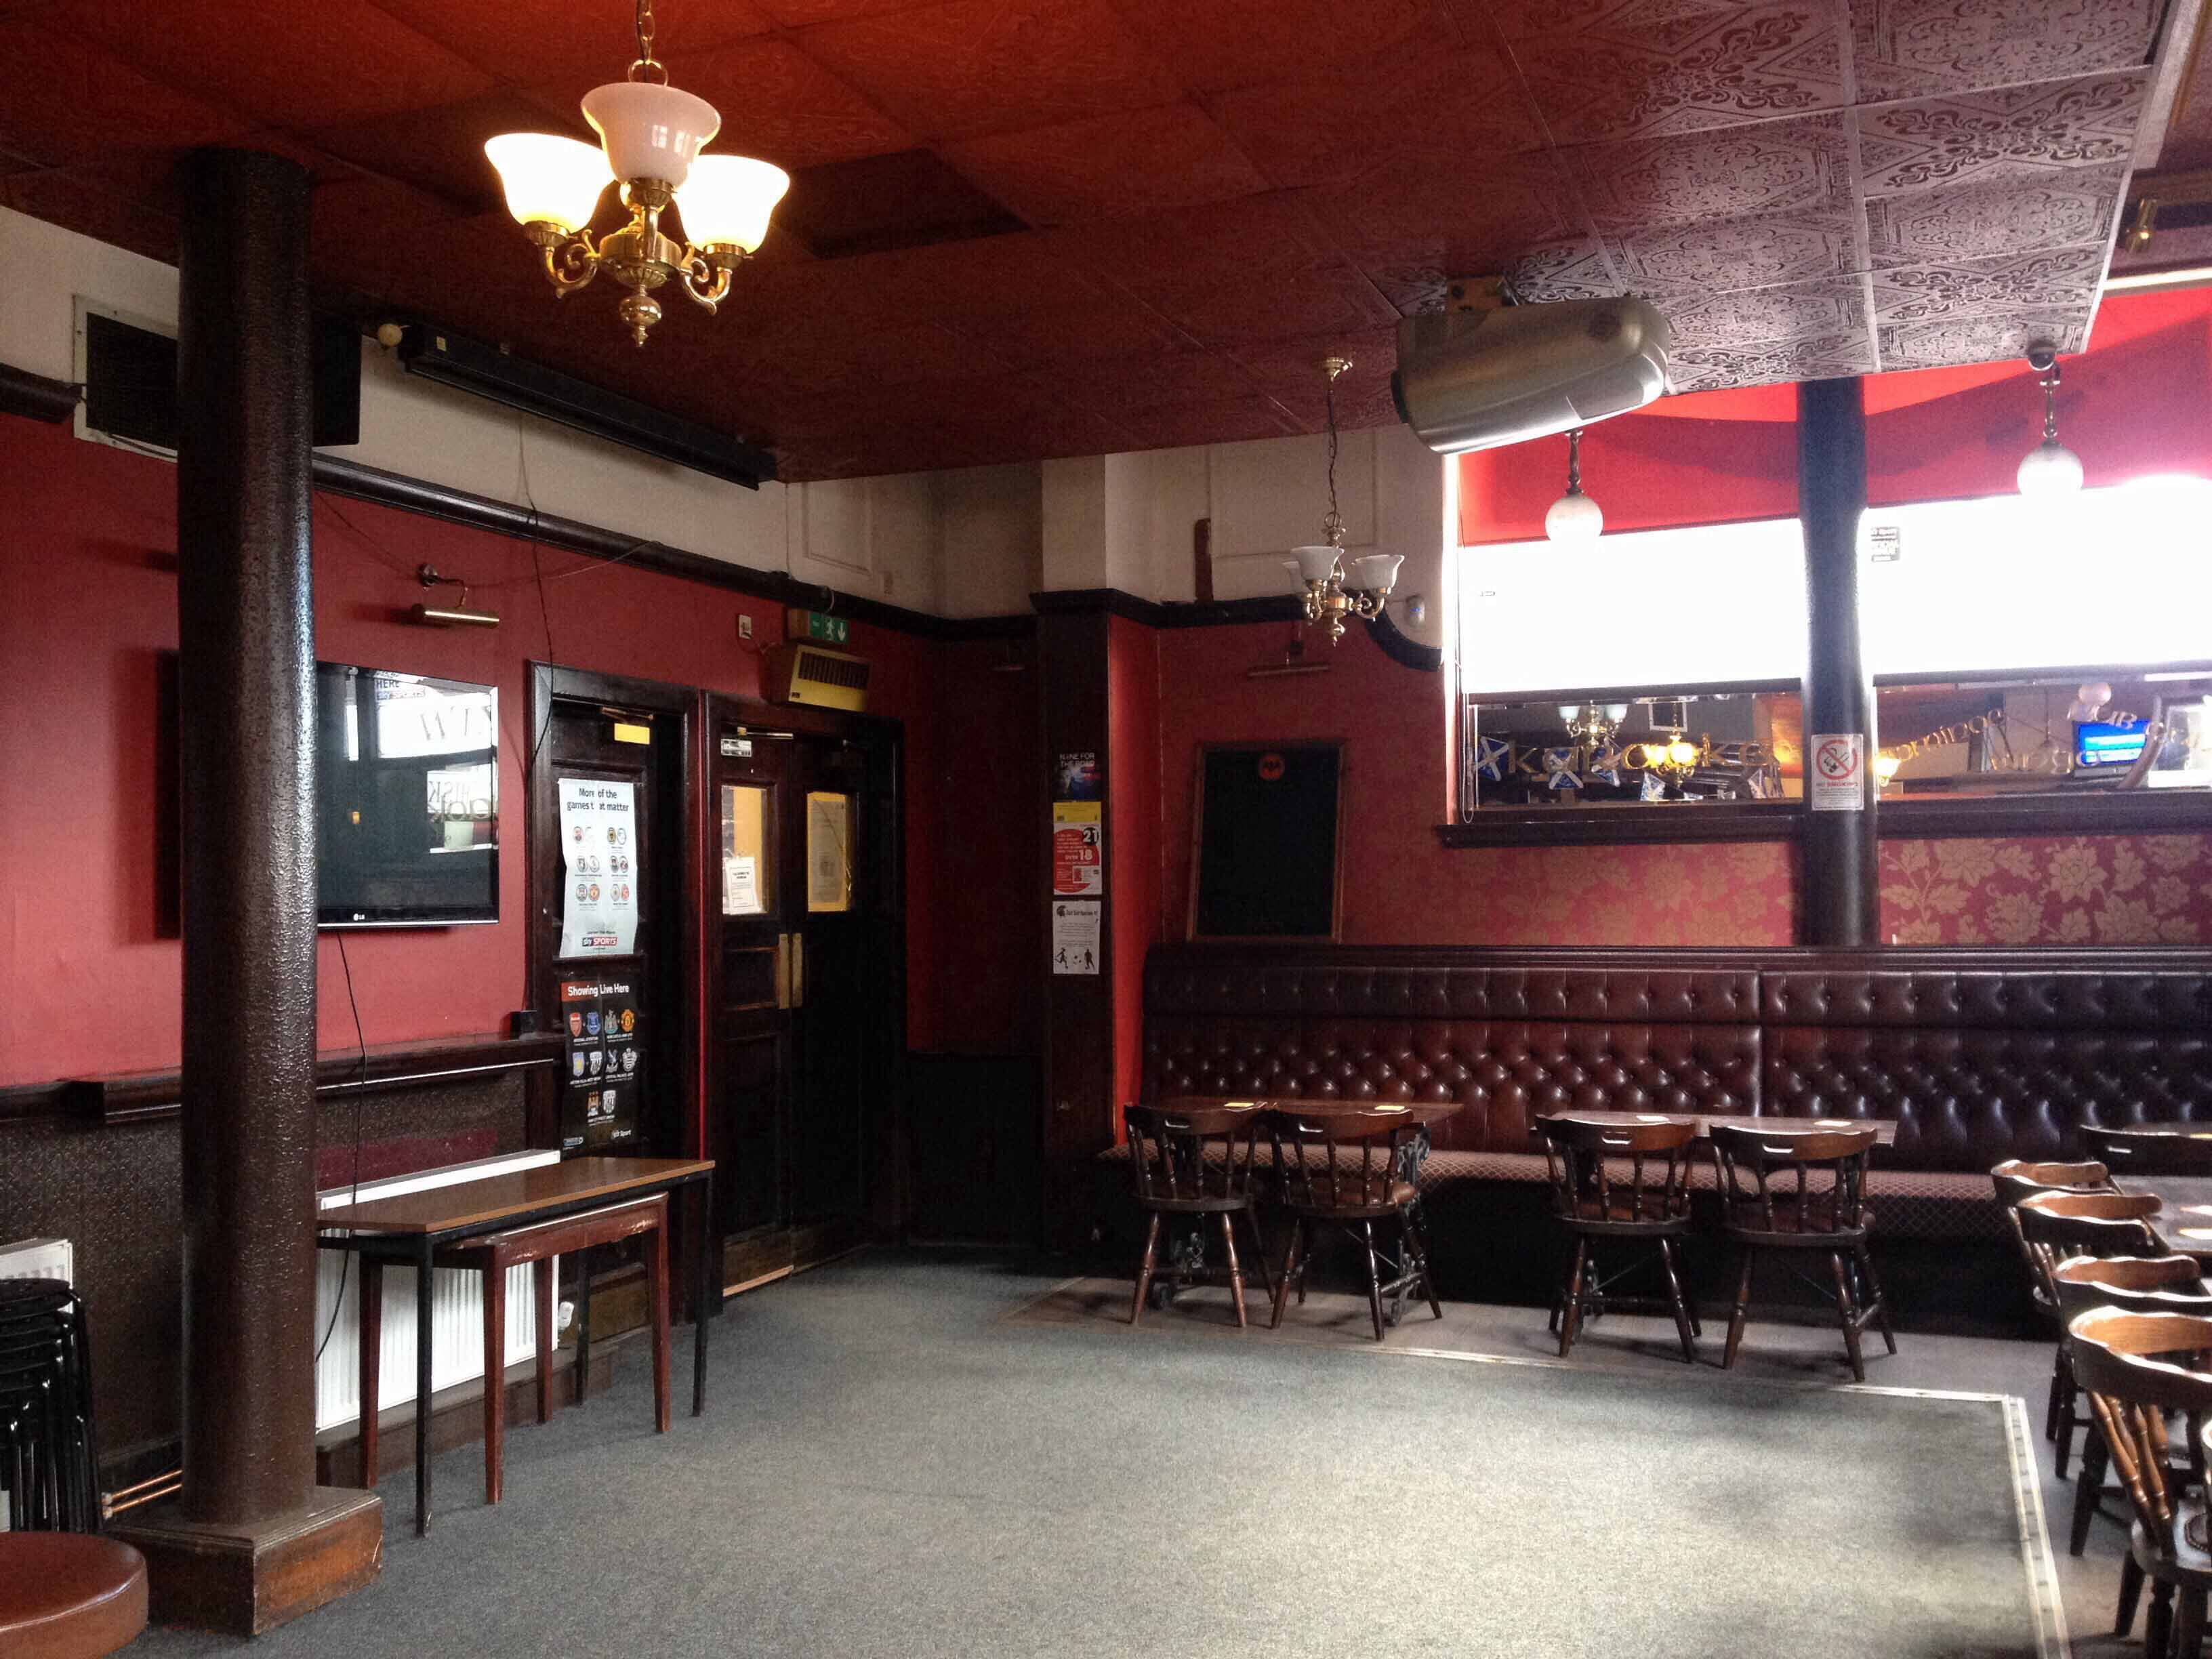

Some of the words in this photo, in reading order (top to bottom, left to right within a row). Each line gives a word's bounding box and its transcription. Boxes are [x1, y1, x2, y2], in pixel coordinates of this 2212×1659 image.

[598, 789, 605, 798] of
[605, 789, 617, 798] the
[567, 802, 590, 811] games
[607, 802, 629, 812] matter
[1083, 830, 1098, 842] 21
[1079, 849, 1092, 861] 18
[594, 937, 617, 946] SPORTS
[567, 985, 598, 997] Showing
[599, 984, 613, 994] Live
[613, 983, 629, 994] Here
